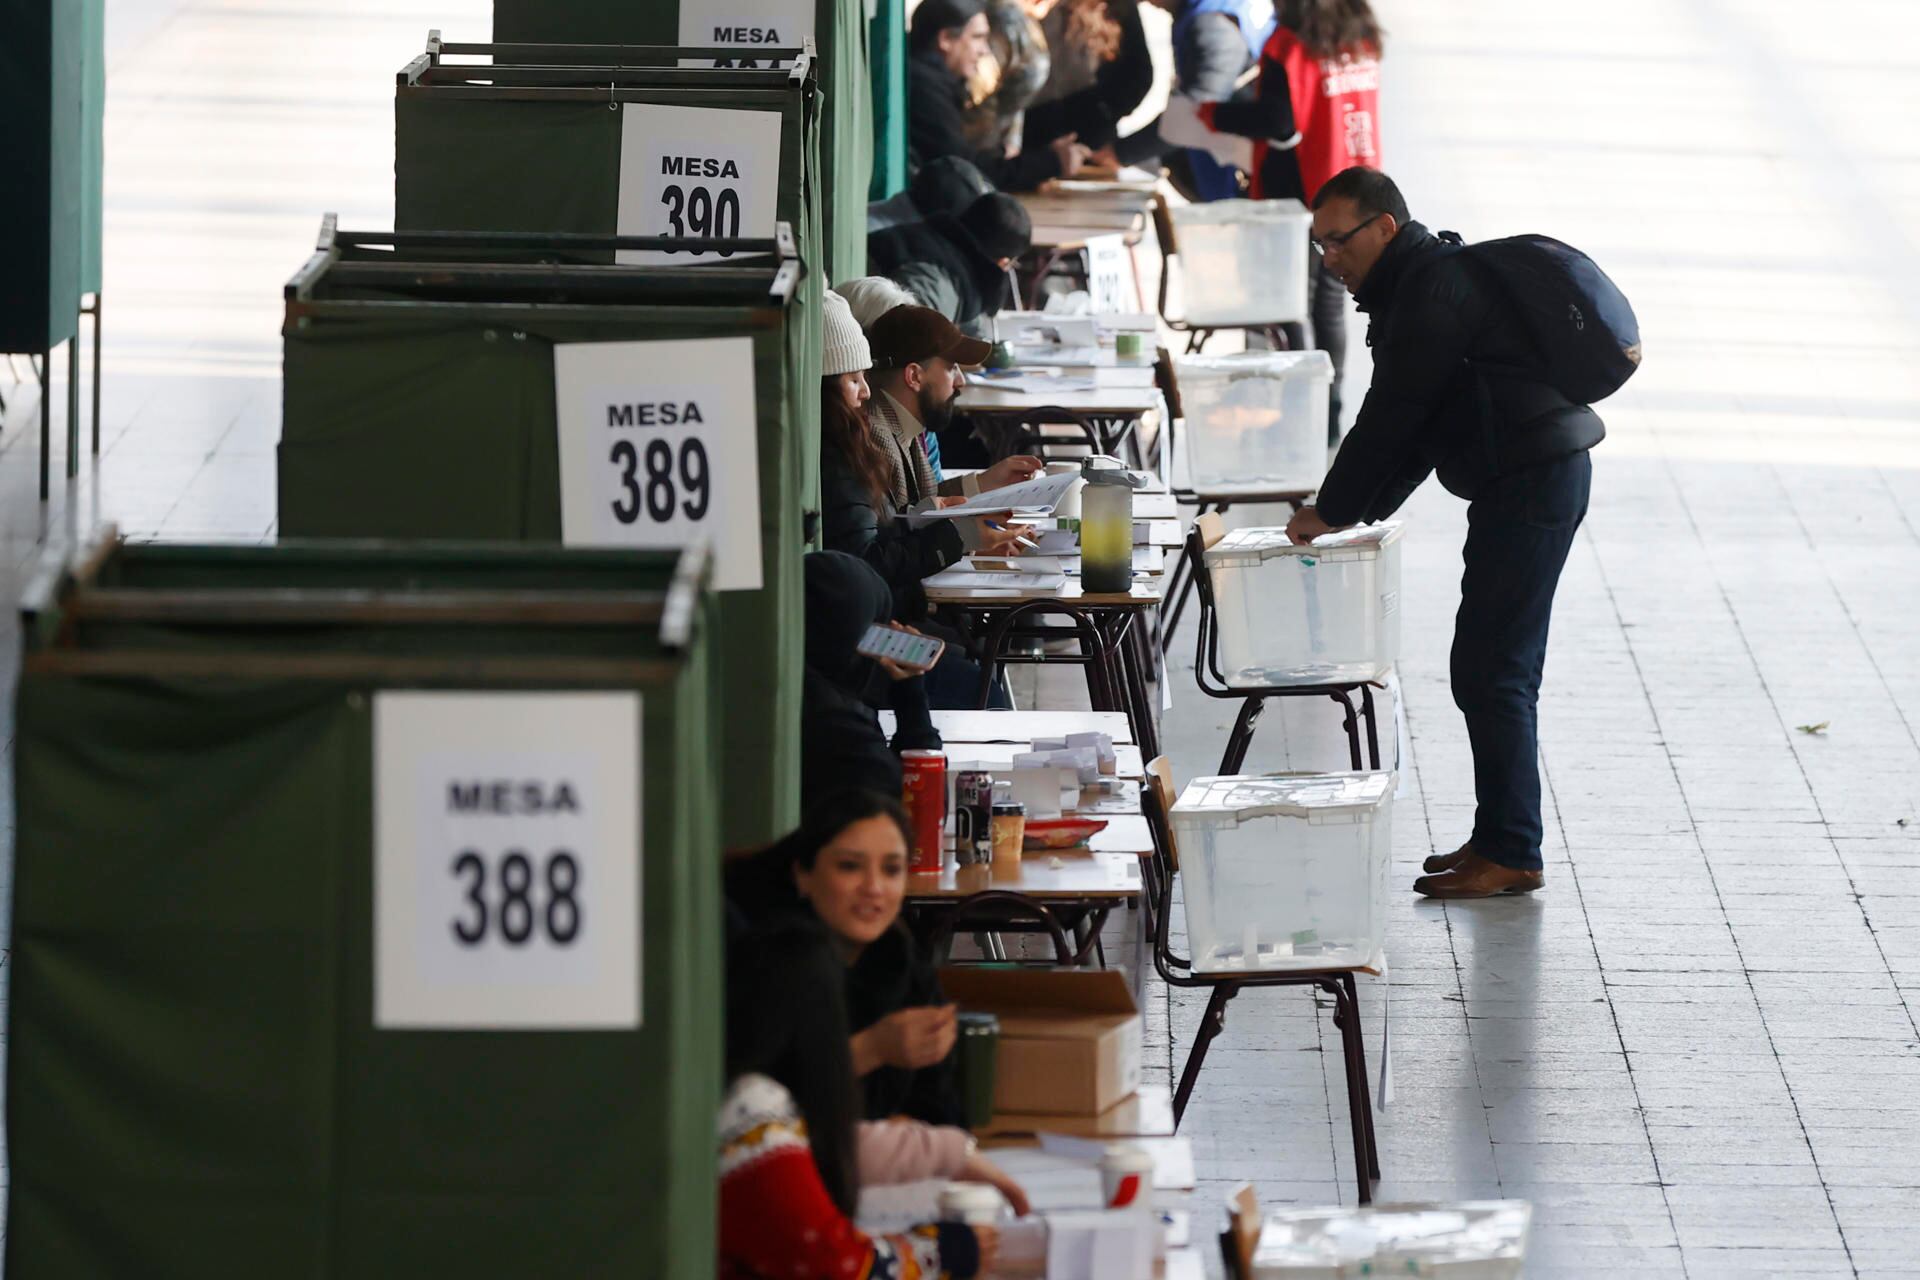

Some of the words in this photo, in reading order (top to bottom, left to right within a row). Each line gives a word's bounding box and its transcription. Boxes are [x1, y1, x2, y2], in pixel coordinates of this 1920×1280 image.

[714, 27, 780, 43] MESA
[661, 156, 740, 179] MESA
[659, 185, 740, 257] 390
[607, 401, 704, 427] MESA
[610, 436, 709, 524] 389
[448, 780, 580, 815] MESA
[452, 851, 580, 946] 388
